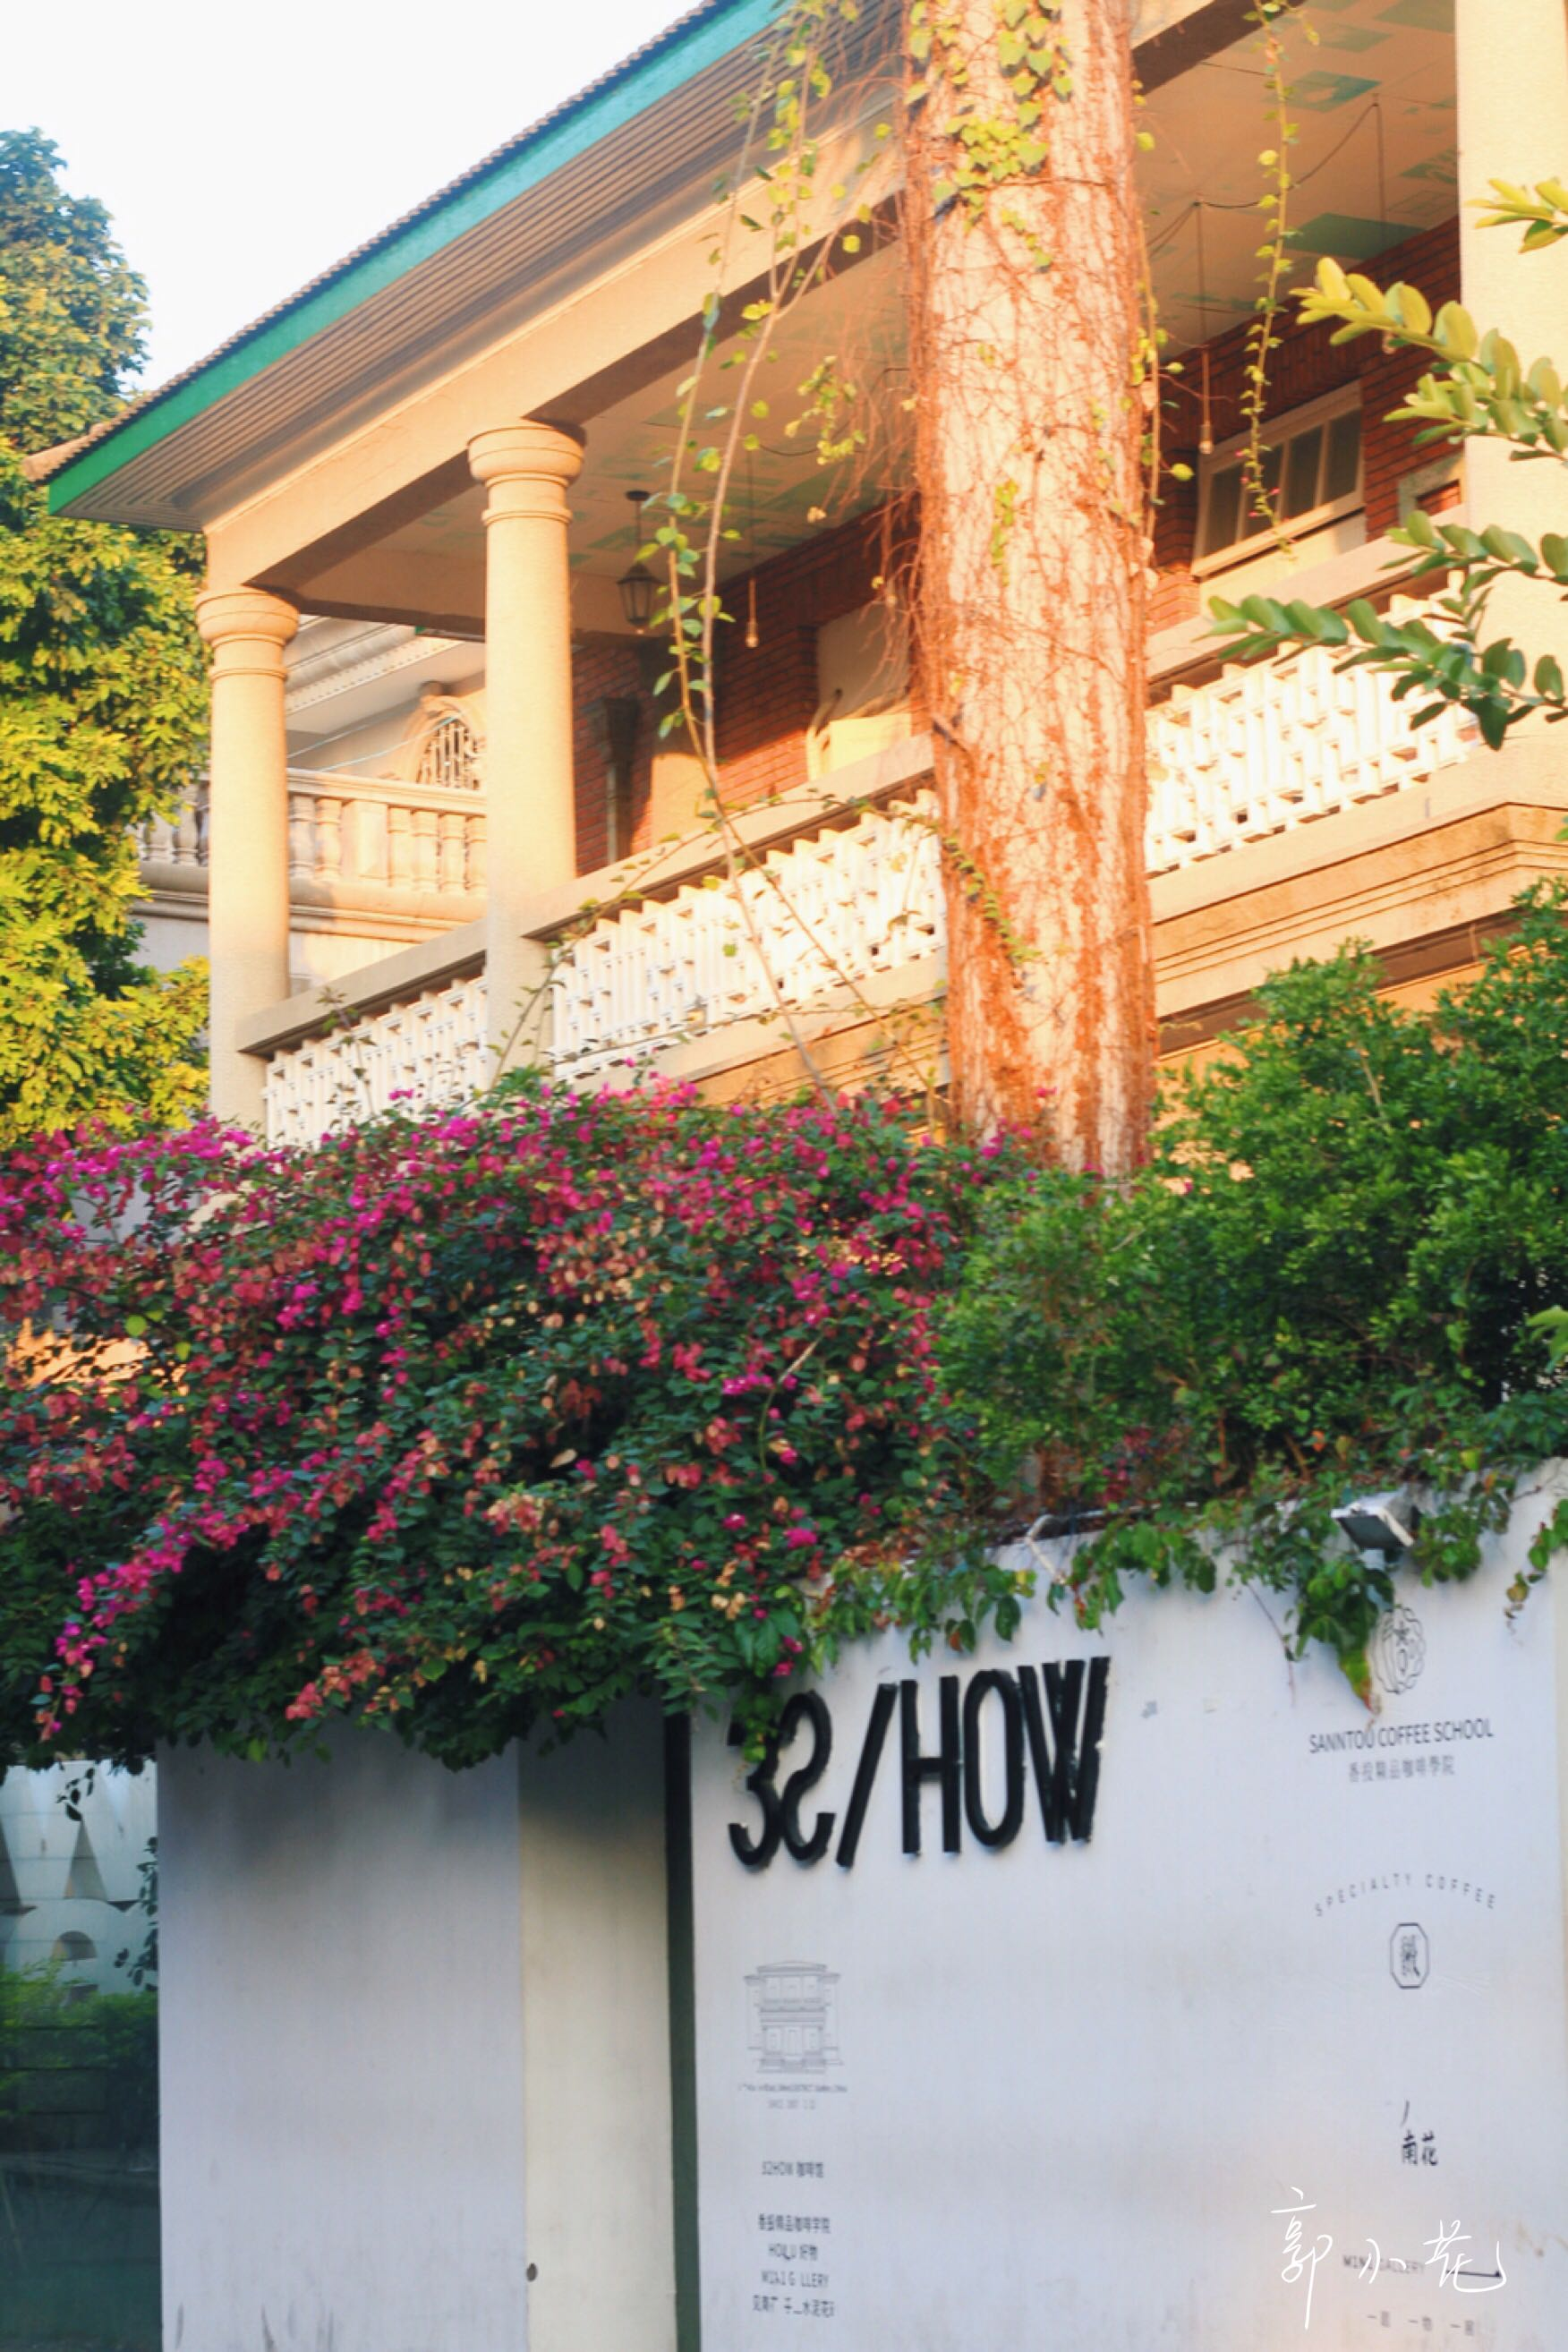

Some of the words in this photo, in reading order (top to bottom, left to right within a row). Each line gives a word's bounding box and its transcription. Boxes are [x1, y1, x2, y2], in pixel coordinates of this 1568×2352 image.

[1309, 1728, 1376, 1754] SANNTOU
[1378, 1723, 1431, 1747] COFFEE
[1433, 1717, 1495, 1743] SCHOOL
[1315, 1872, 1411, 1917] SPECIALTY
[1426, 1872, 1496, 1910] COFFEE
[788, 2271, 831, 2288] GLLERY
